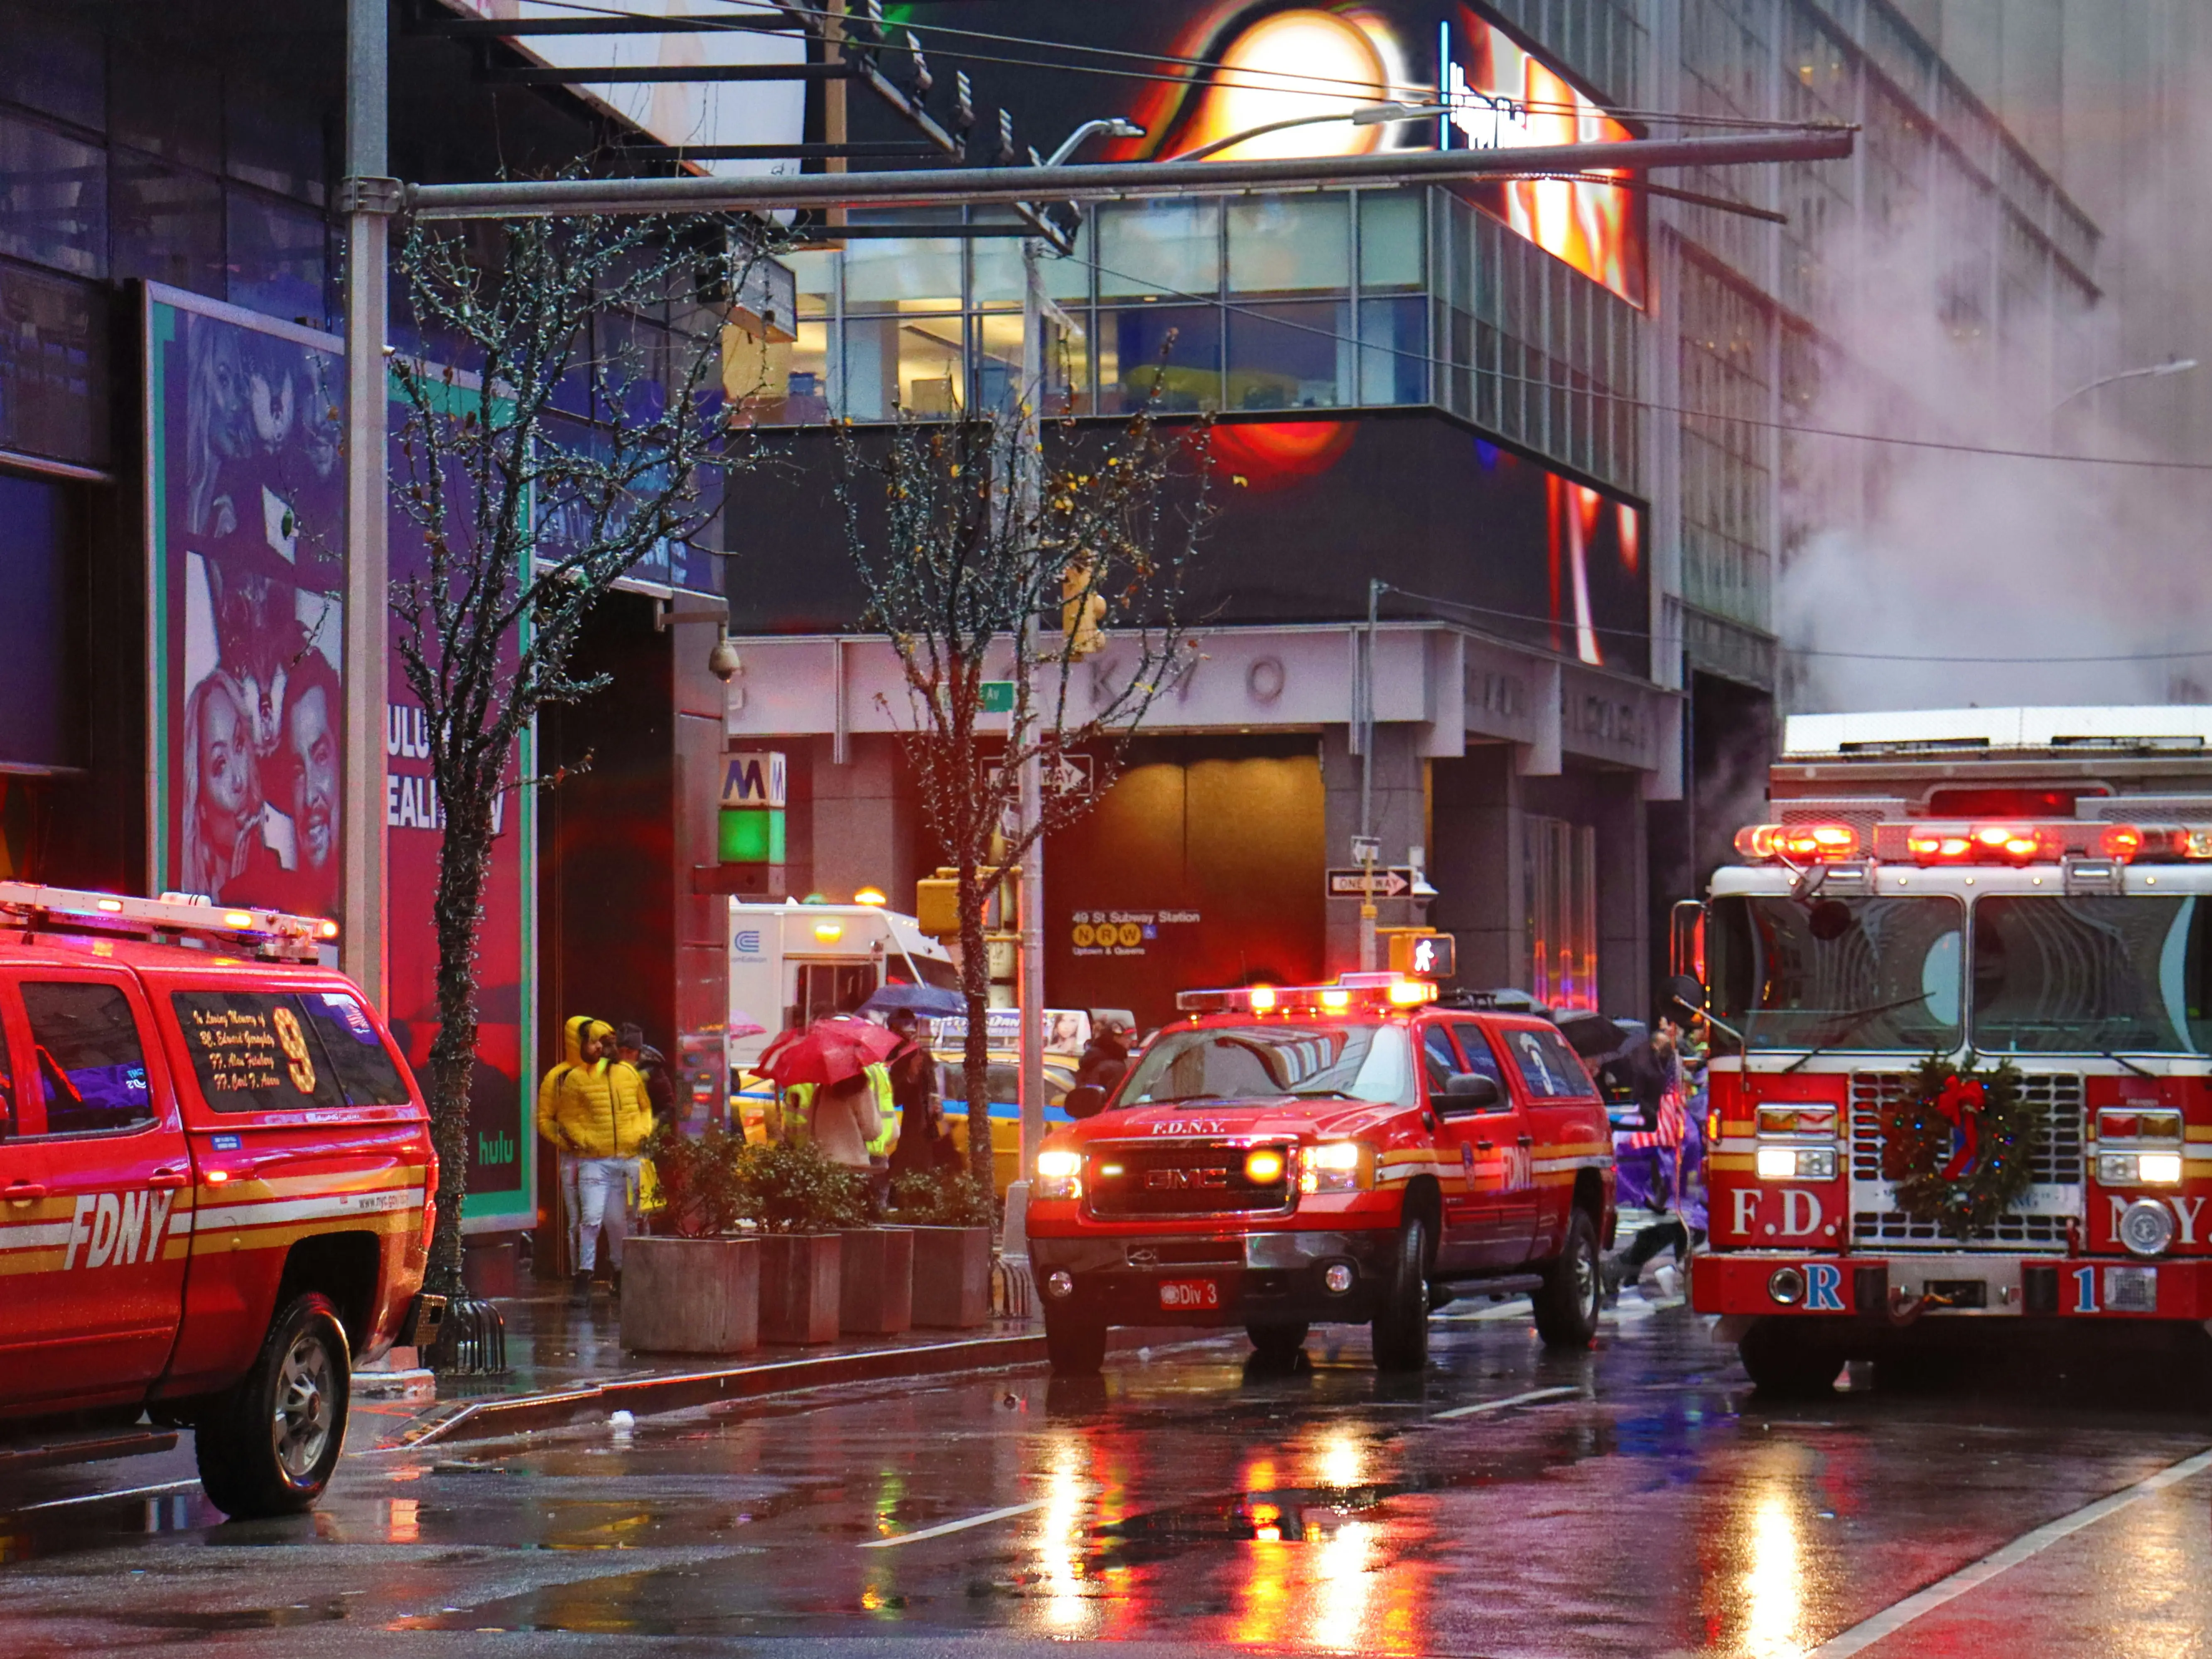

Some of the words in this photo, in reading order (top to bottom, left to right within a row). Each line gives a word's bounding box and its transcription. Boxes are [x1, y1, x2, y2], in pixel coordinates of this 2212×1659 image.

[387, 705, 430, 759] ULU
[722, 760, 766, 800] M
[1339, 878, 1363, 890] ONE
[1375, 879, 1398, 890] WAY
[1072, 911, 1089, 923] 49
[1092, 911, 1106, 923] St
[1110, 911, 1155, 925] Subway
[1158, 910, 1201, 923] Station
[1078, 929, 1090, 941] N
[1101, 929, 1112, 941] R
[1123, 929, 1137, 941] W
[273, 1005, 316, 1094] 9
[1152, 1122, 1225, 1134] F.D.N.Y.
[479, 1131, 513, 1164] hulu
[1144, 1168, 1227, 1189] GMC
[1731, 1189, 1836, 1236] F.D.
[64, 1189, 174, 1270] FDNY
[1180, 1285, 1201, 1304] Div
[1207, 1283, 1217, 1303] 3
[1801, 1263, 1845, 1310] R
[2073, 1265, 2100, 1312] 1
